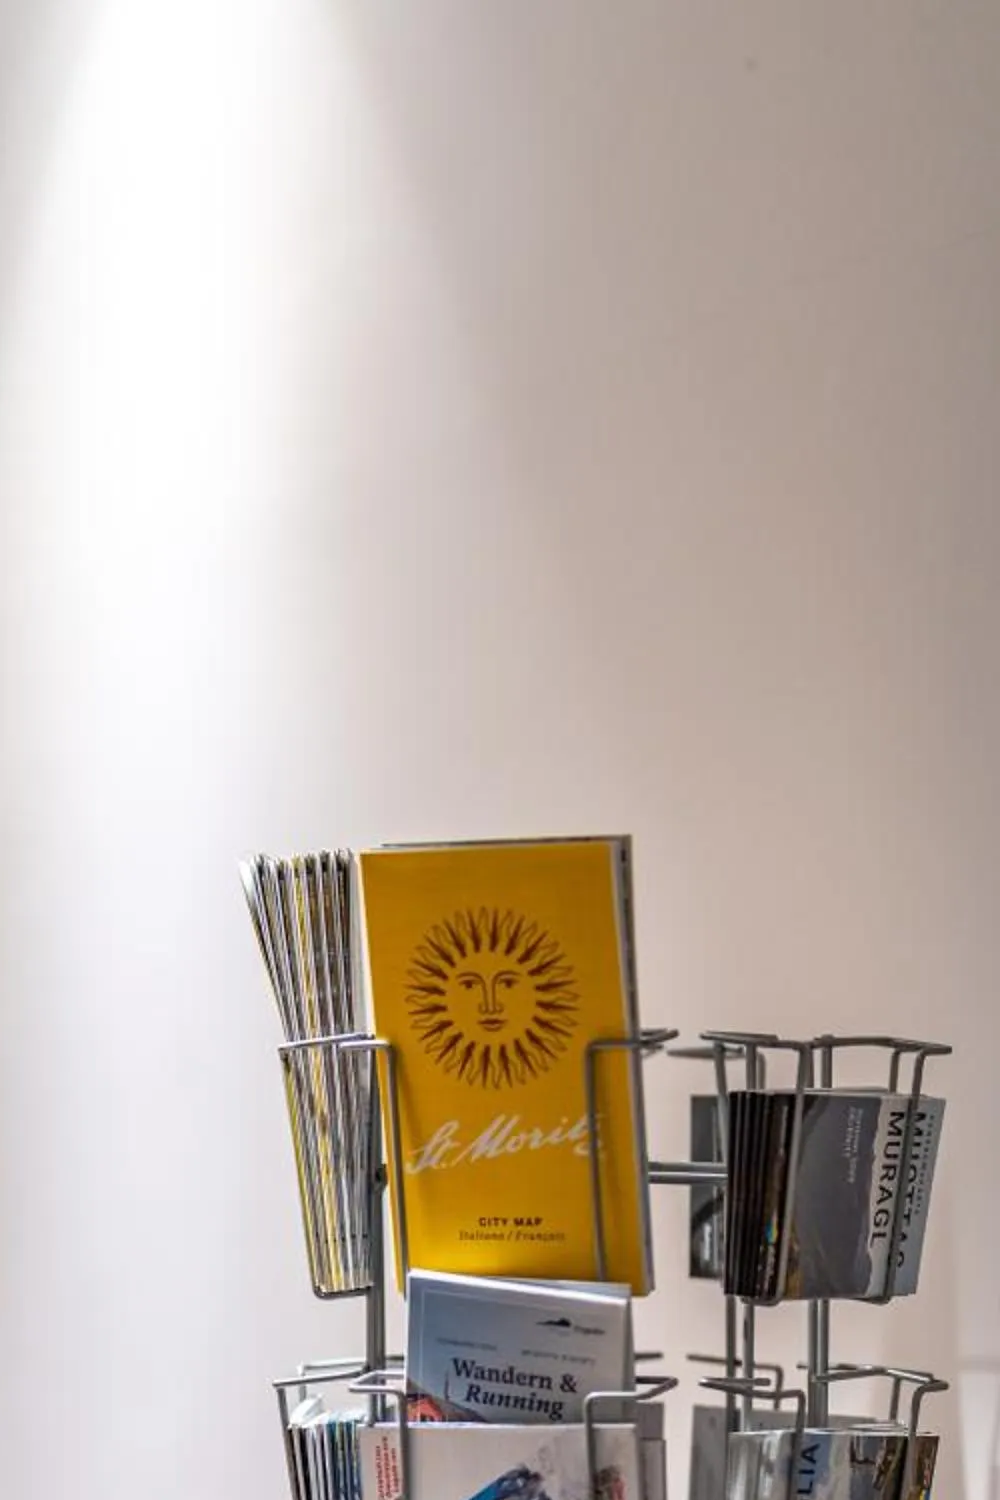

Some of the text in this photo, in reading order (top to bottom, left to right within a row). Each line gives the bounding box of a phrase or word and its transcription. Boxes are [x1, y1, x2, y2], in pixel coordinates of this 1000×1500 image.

[870, 1111, 905, 1249] MURAGL
[478, 1216, 544, 1228] CITY MAP
[452, 1357, 553, 1391] Wandern
[558, 1371, 578, 1394] &
[464, 1383, 566, 1421] Running
